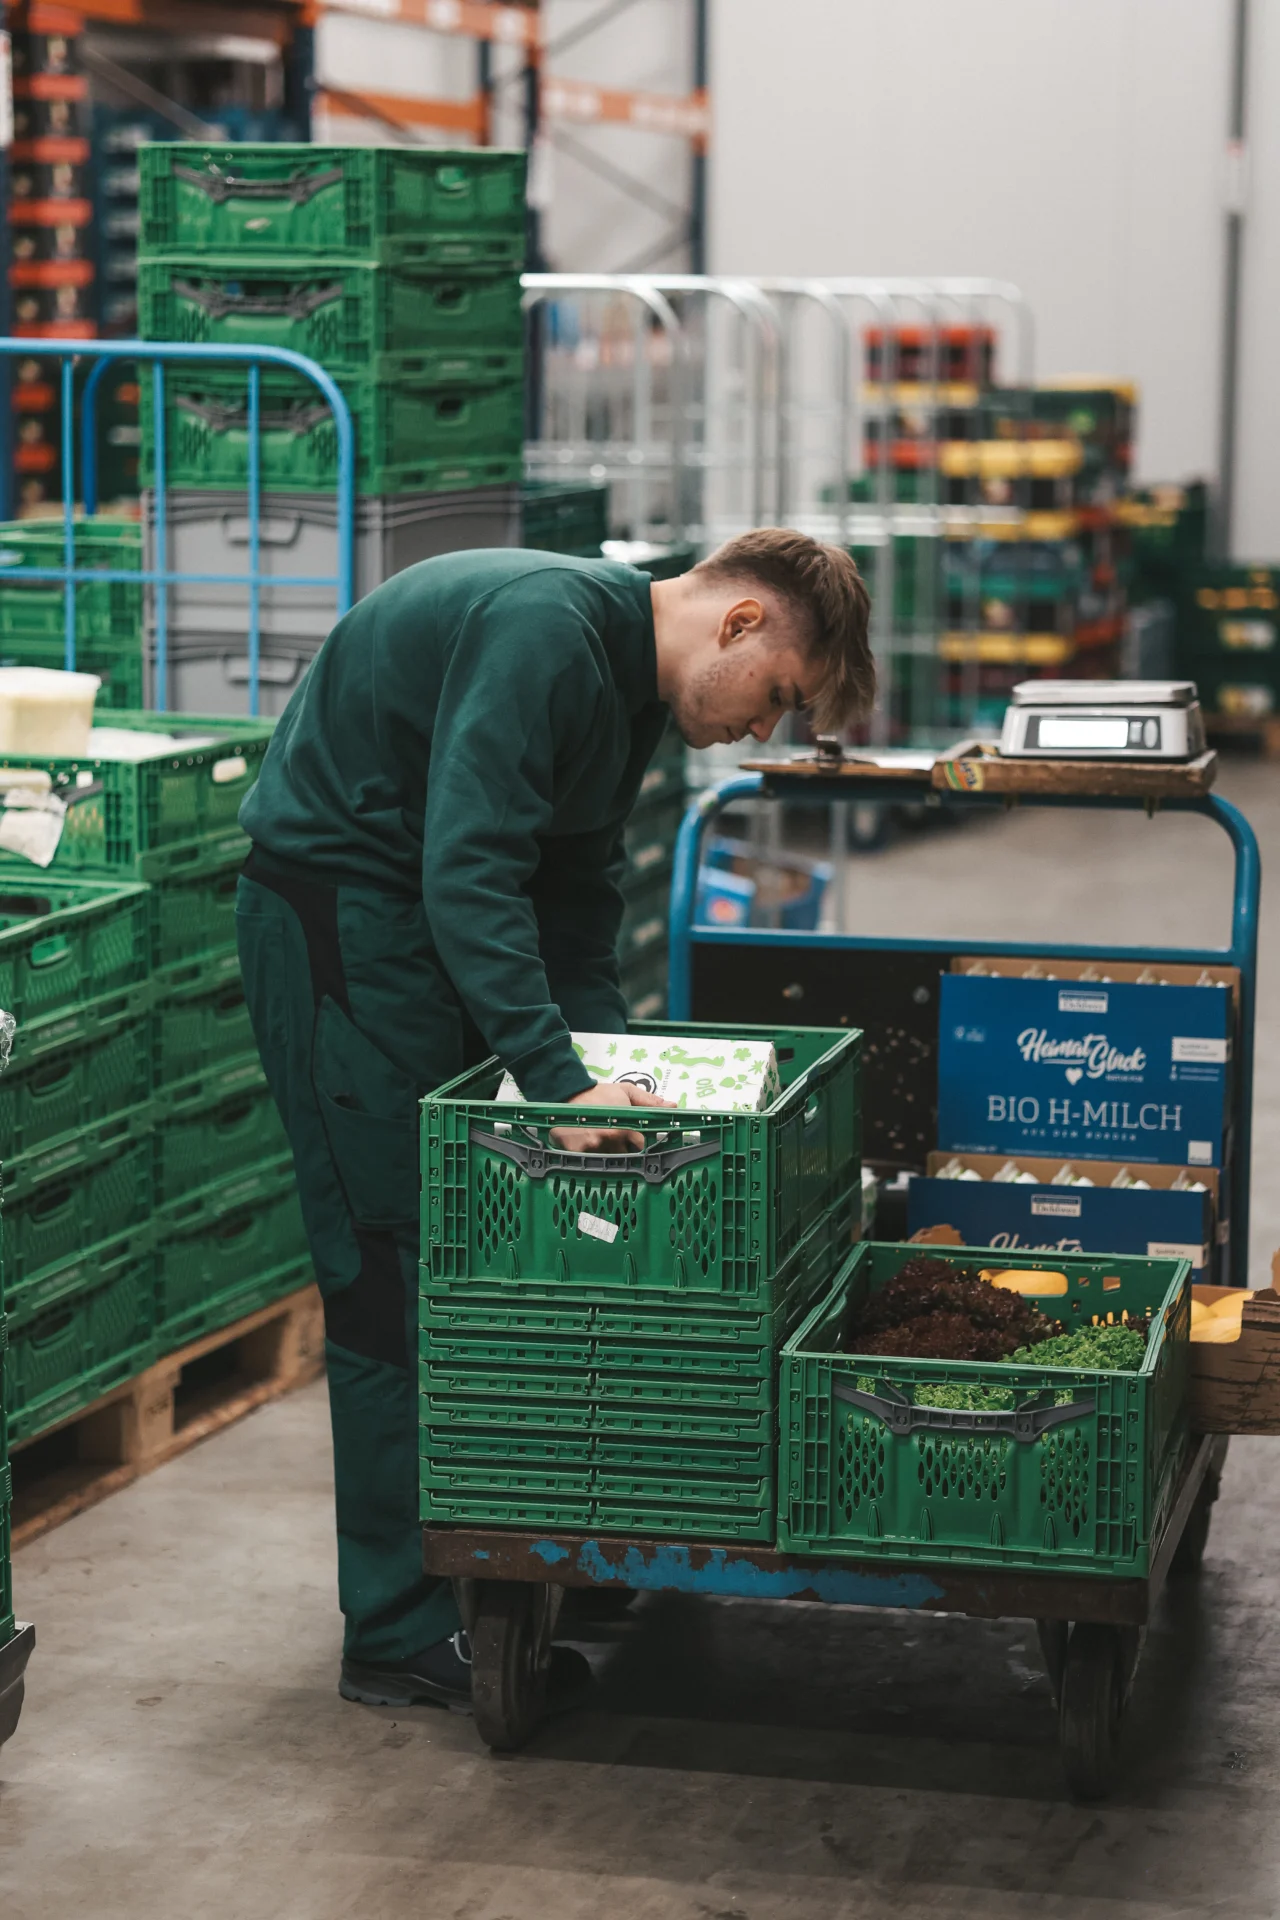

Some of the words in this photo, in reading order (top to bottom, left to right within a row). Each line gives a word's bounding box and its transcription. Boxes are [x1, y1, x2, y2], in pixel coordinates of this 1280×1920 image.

[1017, 1028, 1106, 1062] Heimat
[695, 1077, 717, 1098] BIO
[987, 1095, 1040, 1124] BIO
[1047, 1098, 1182, 1132] H-MILCH
